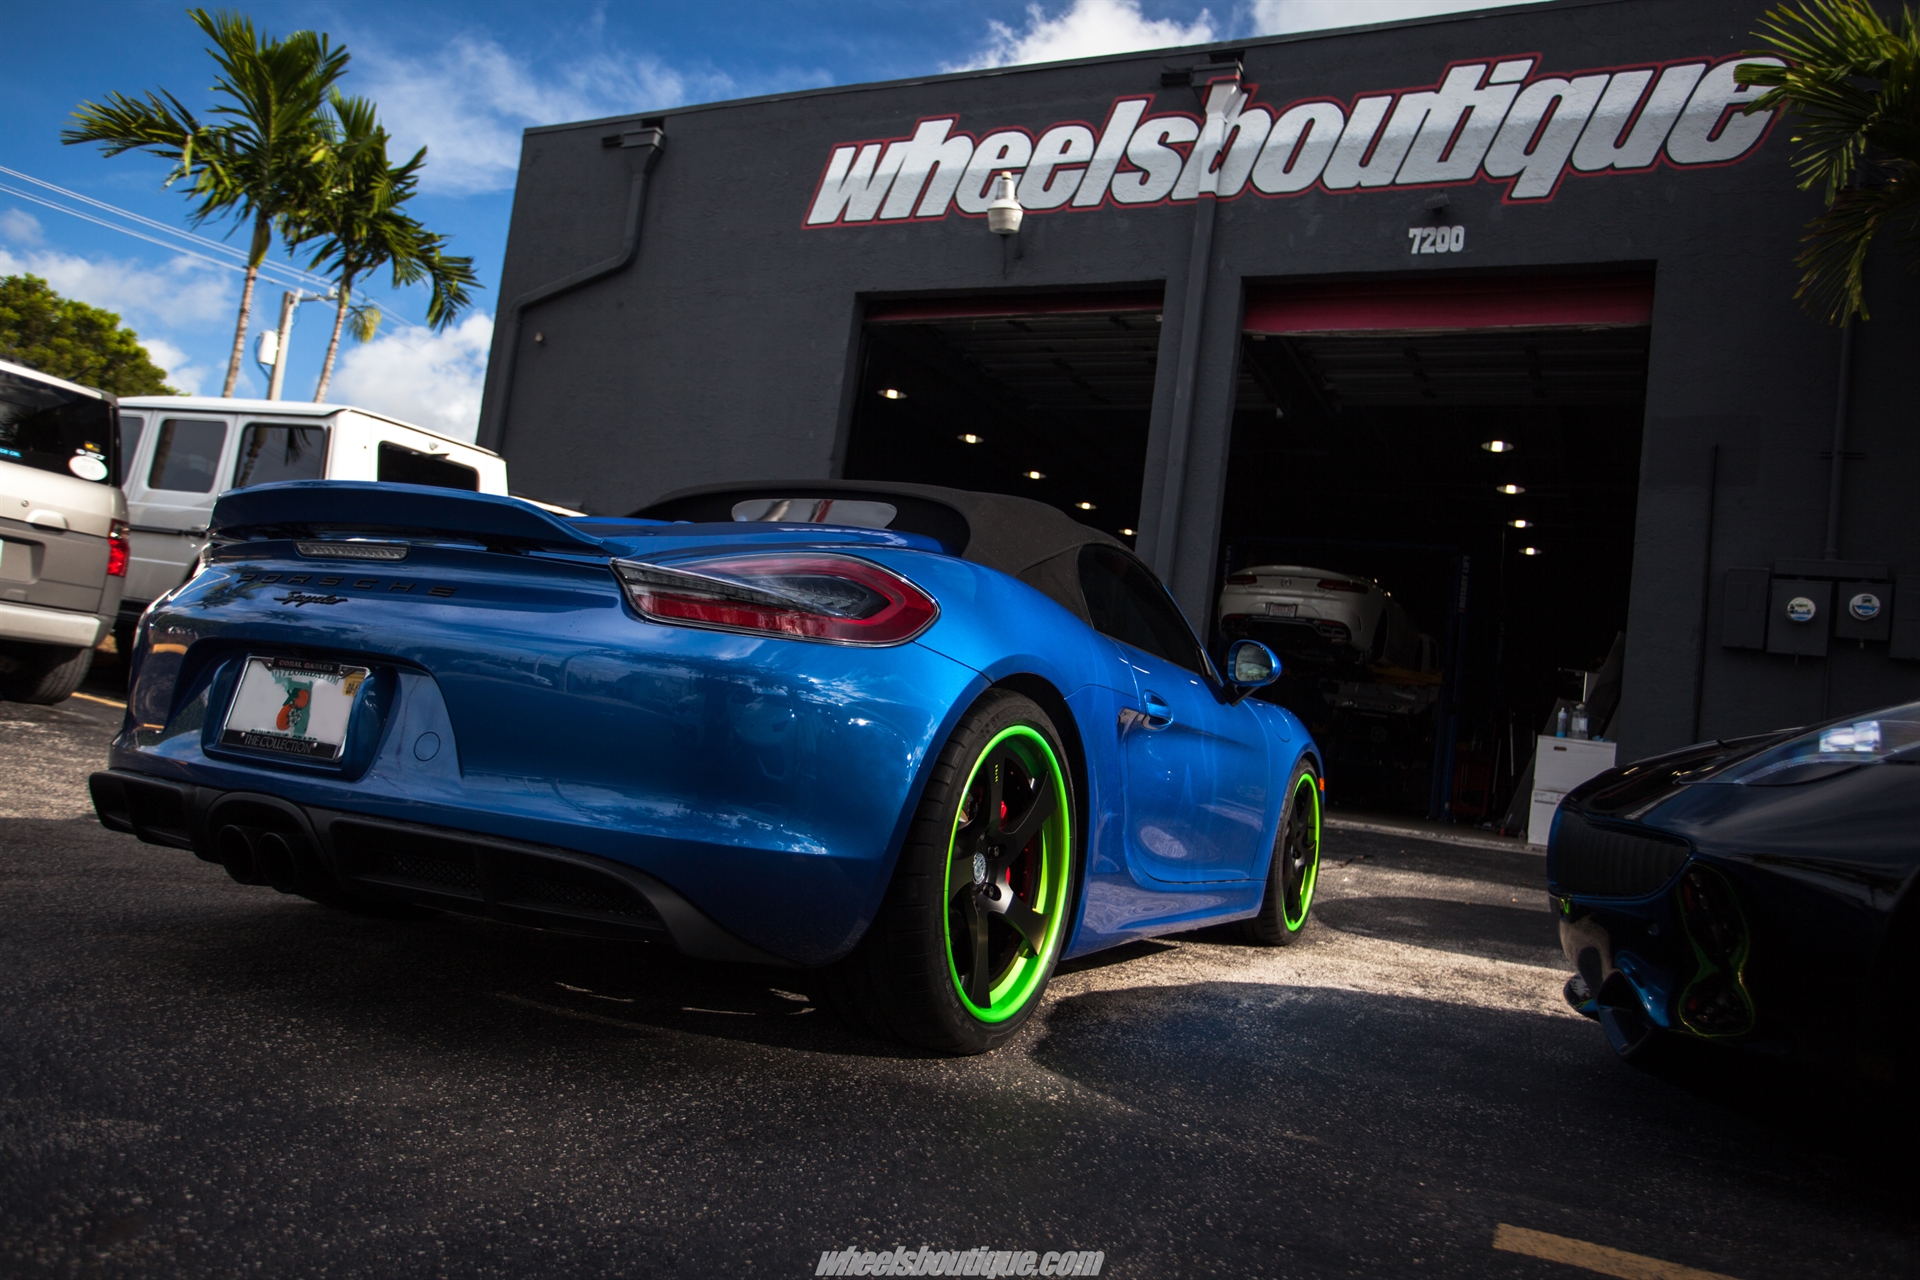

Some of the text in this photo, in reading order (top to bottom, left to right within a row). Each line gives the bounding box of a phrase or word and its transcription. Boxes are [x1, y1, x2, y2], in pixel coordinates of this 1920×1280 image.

[804, 53, 1789, 228] wheelsboutique
[1408, 225, 1465, 254] 7200
[1461, 555, 1471, 574] LIFT
[236, 573, 458, 598] PORSCHE
[273, 591, 348, 608] Spyder
[279, 660, 333, 671] CORAL GABLES
[244, 734, 260, 746] THE
[259, 736, 313, 753] COLLECTION
